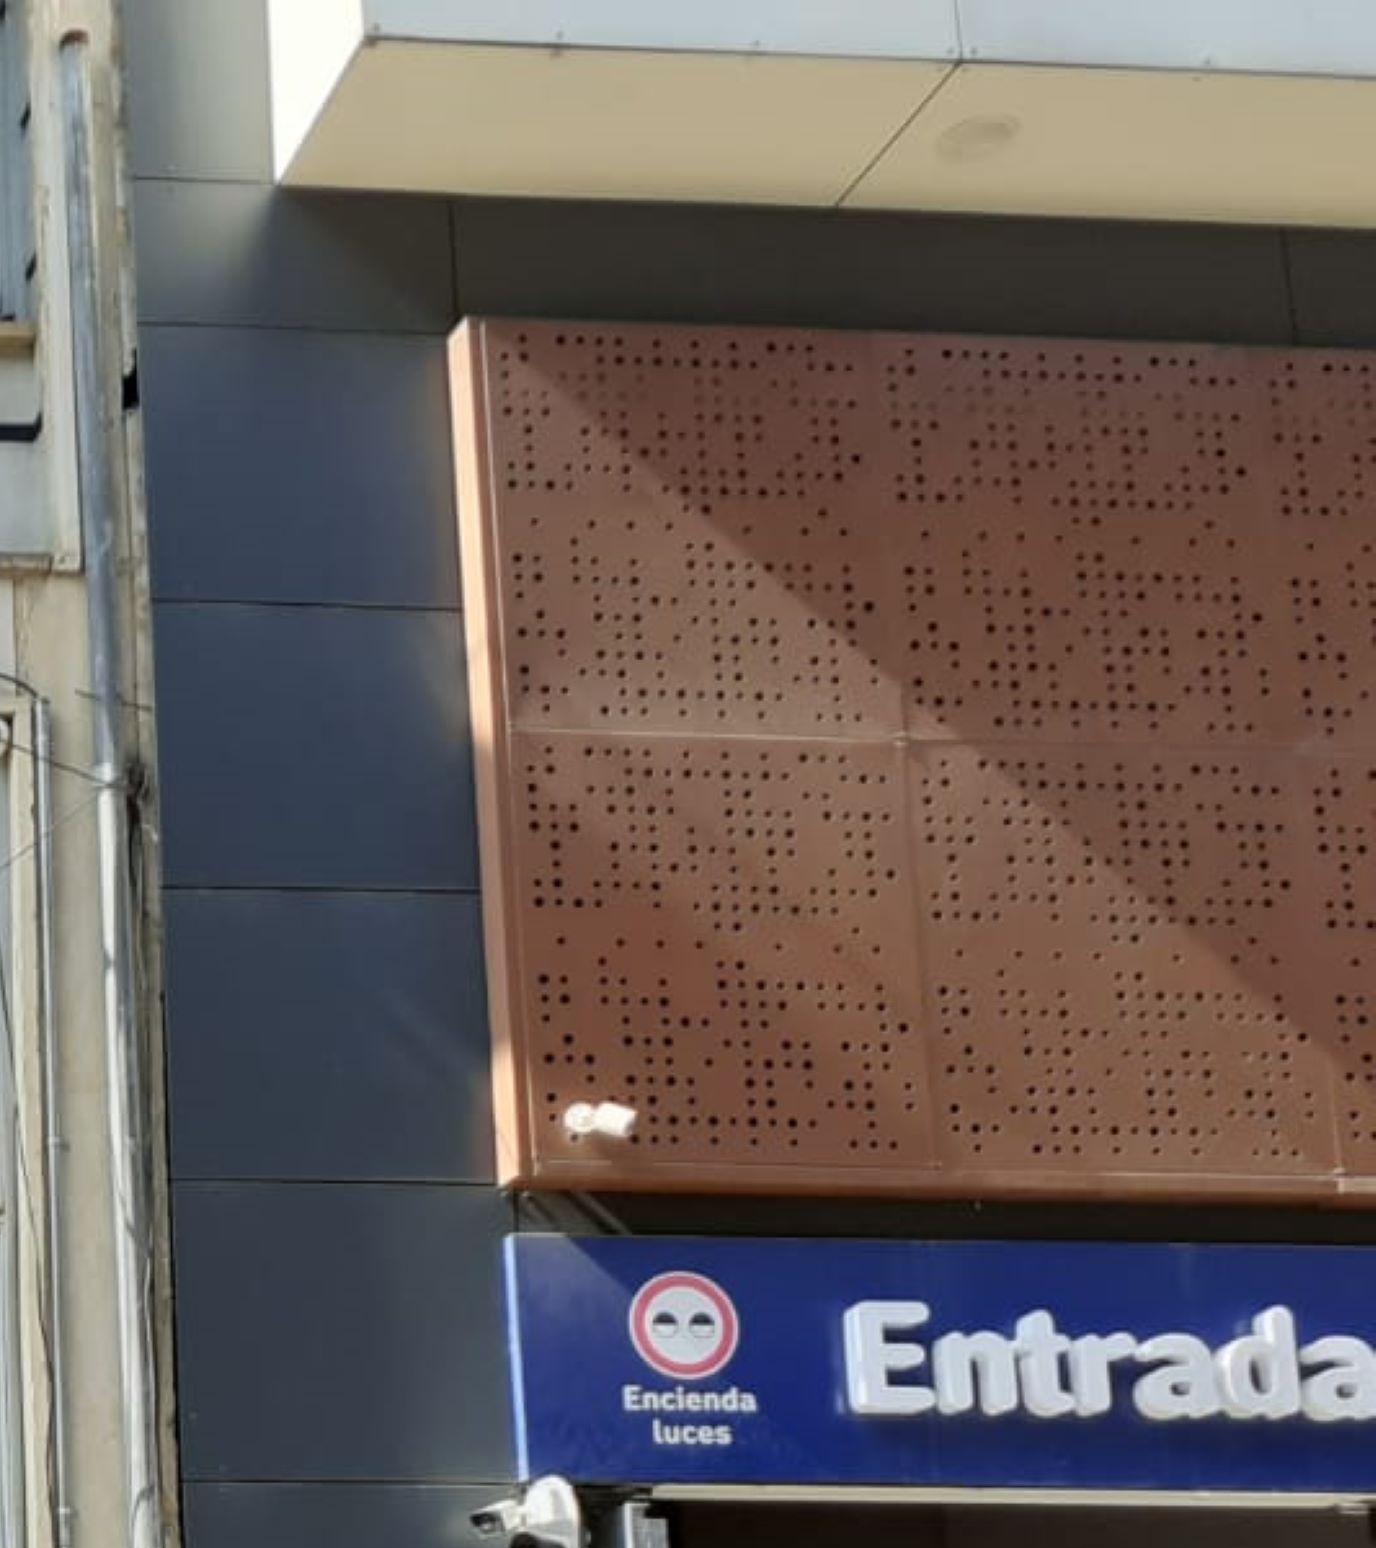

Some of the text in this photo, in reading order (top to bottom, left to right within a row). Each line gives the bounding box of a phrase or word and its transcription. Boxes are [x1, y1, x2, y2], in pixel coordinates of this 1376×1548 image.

[844, 1300, 1376, 1421] Entrada
[622, 1384, 758, 1412] Encienda
[652, 1419, 733, 1445] luces
